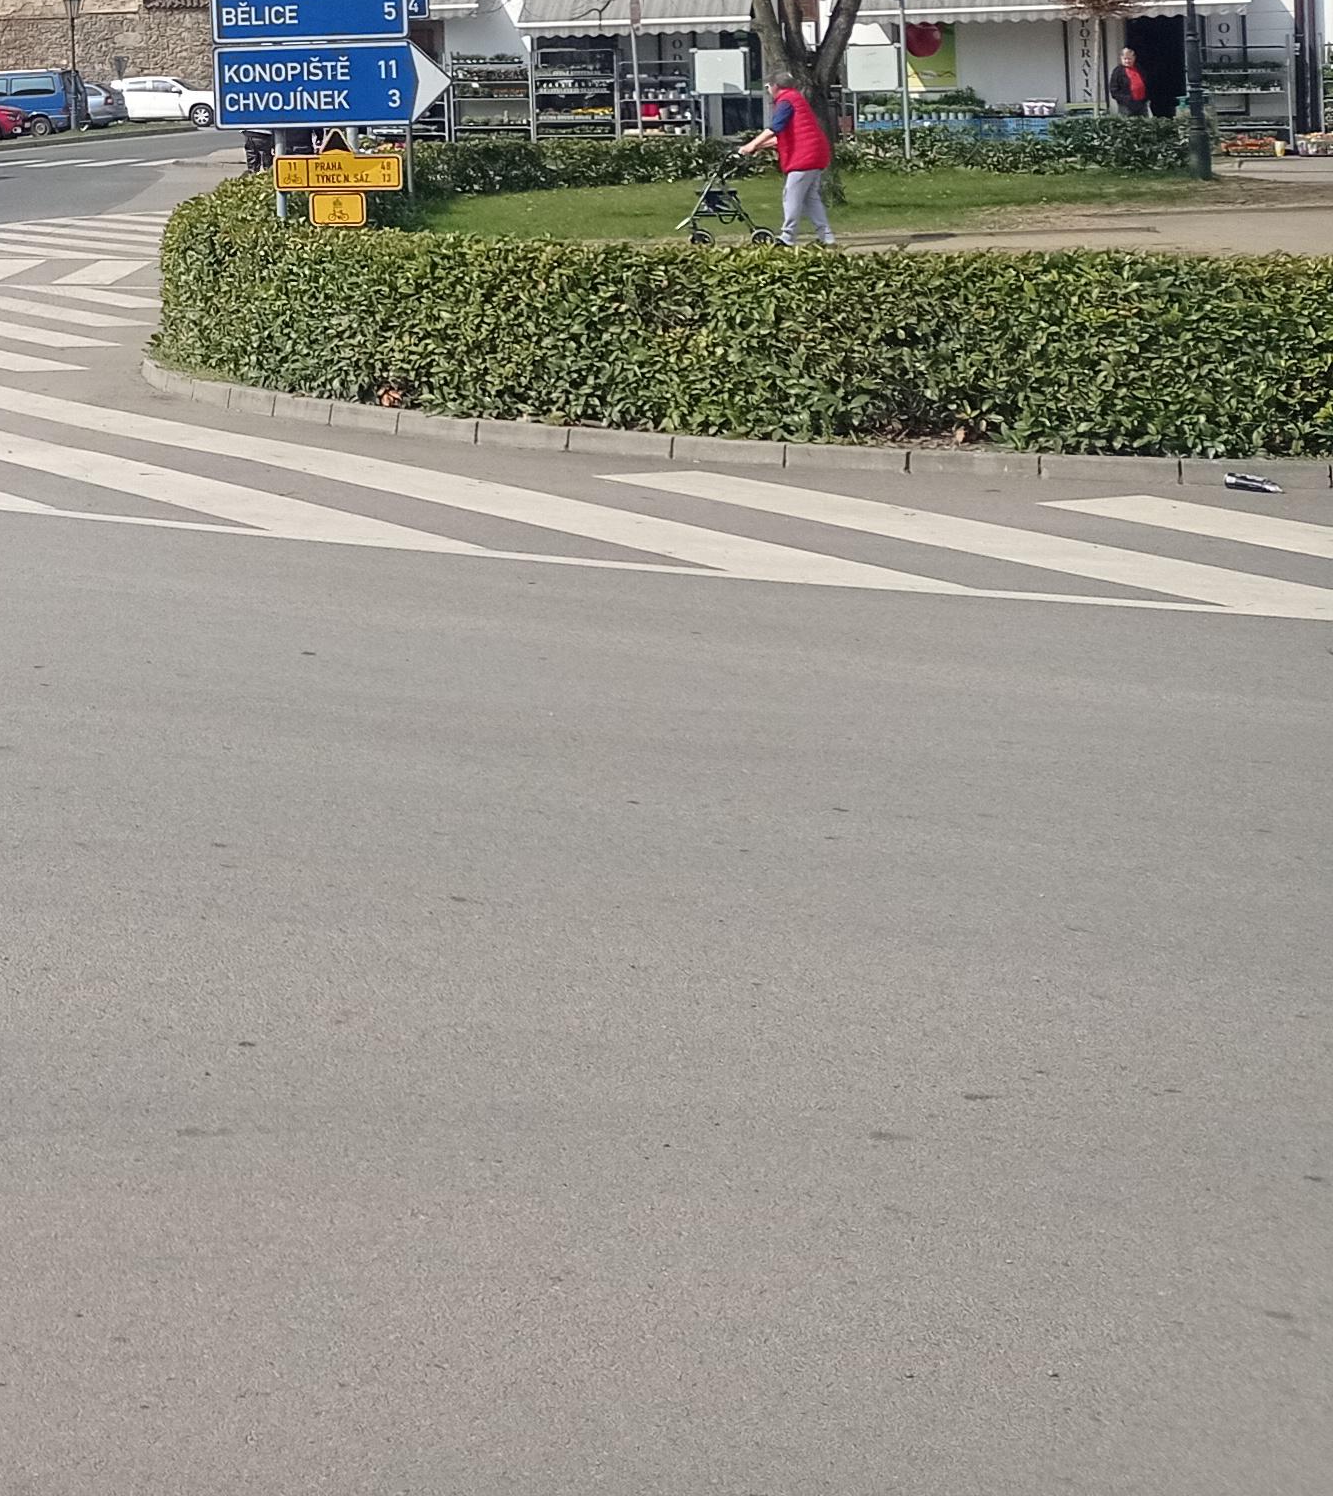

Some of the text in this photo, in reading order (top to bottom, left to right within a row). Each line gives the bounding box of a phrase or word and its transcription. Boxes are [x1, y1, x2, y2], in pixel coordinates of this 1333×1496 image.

[222, 2, 396, 26] BĚLICE 5
[224, 56, 397, 84] KONOPIŠTĚ 11
[225, 87, 401, 112] CHVOJÍNEK 3
[287, 161, 391, 171] 11 PRAHA 48
[382, 174, 392, 183] 13
